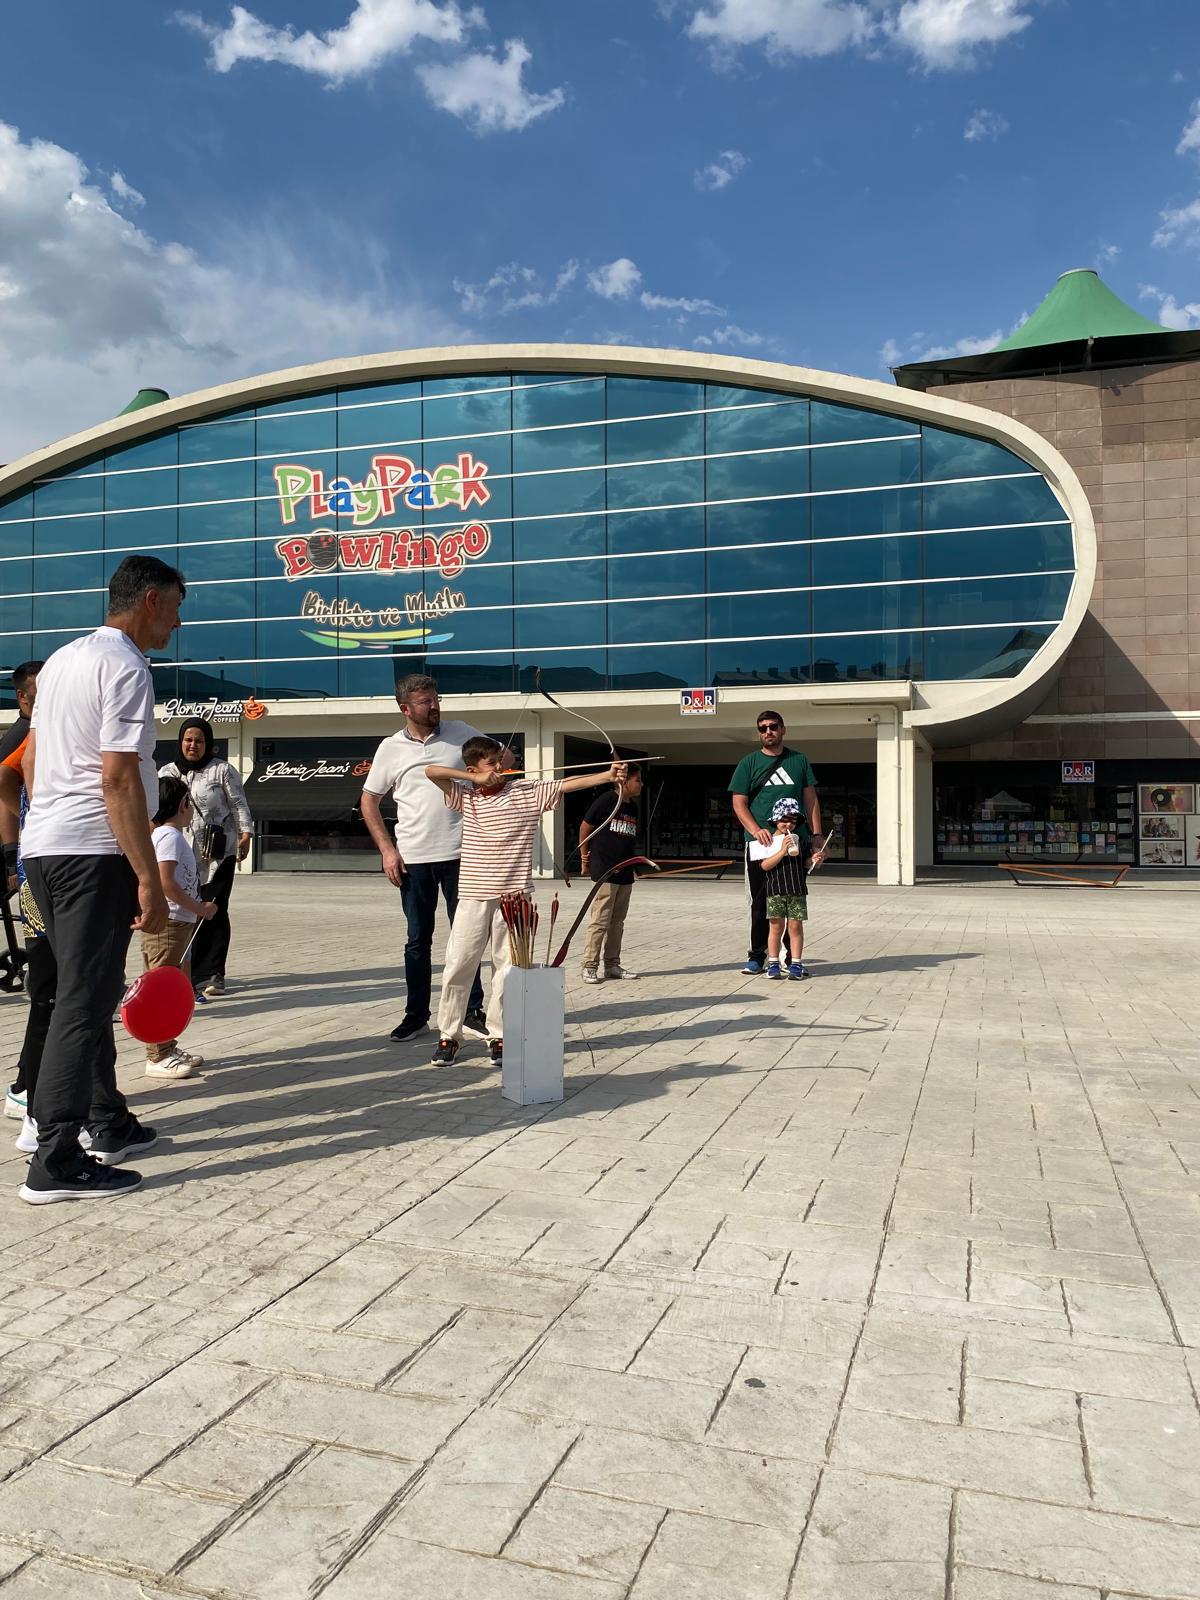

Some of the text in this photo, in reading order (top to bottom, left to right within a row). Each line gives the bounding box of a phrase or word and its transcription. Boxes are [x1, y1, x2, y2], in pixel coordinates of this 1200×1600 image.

[302, 586, 466, 628] Birlikte ve Mutlu
[160, 698, 203, 724] Gloria
[682, 695, 714, 708] D&R
[258, 760, 351, 783] Gloria Jean's
[1064, 766, 1093, 777] D&R
